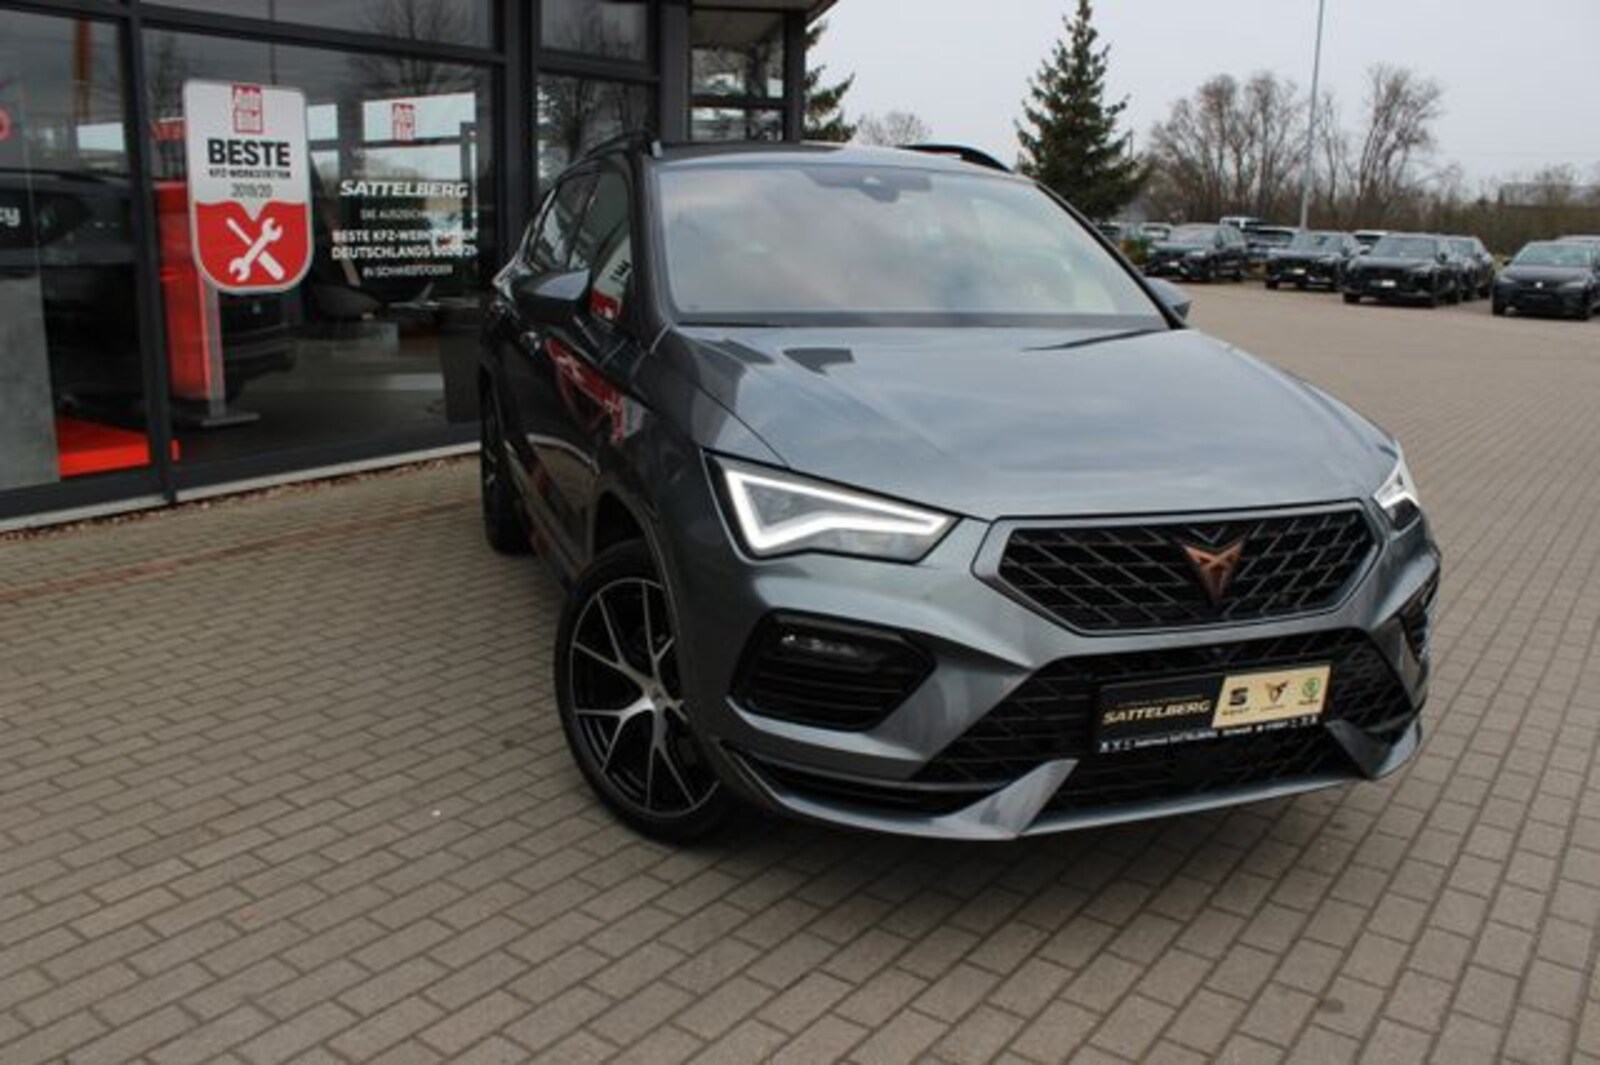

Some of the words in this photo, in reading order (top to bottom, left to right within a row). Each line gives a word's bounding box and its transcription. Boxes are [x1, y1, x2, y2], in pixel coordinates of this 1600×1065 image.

[207, 138, 291, 167] BESTE
[339, 179, 469, 197] SATTELBERG
[331, 229, 370, 243] BESTE
[331, 246, 430, 260] DEUTSCHLANDS
[1103, 701, 1211, 725] SATTELBERG
